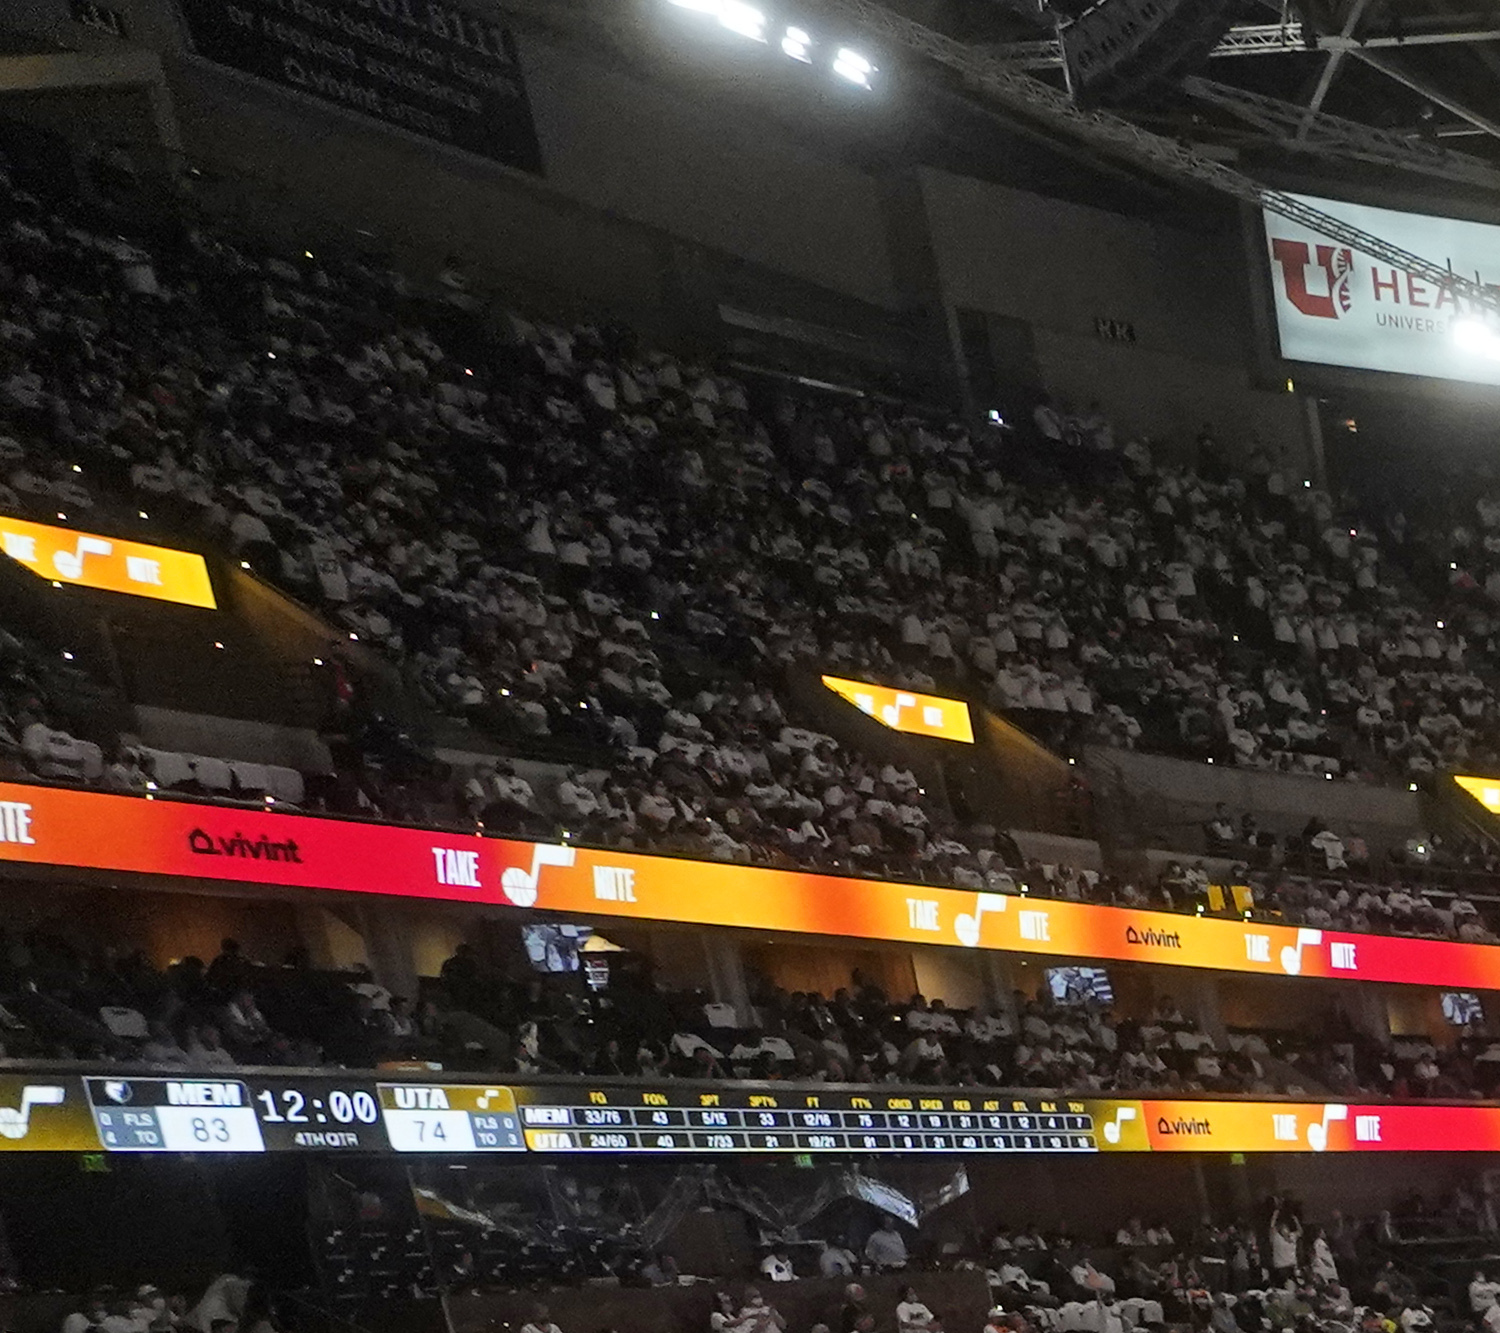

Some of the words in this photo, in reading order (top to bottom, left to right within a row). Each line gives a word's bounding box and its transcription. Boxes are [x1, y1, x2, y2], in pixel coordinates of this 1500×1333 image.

[216, 831, 302, 864] vivint
[1138, 928, 1182, 949] vivint
[166, 1081, 241, 1107] MEM
[394, 1086, 451, 1110] UTA
[258, 1088, 378, 1124] 12:00
[526, 1110, 571, 1125] MEM
[1170, 1118, 1212, 1136] vivint
[136, 1129, 159, 1145] TO
[192, 1118, 230, 1142] 83
[412, 1120, 447, 1142] 74
[480, 1131, 498, 1146] TO
